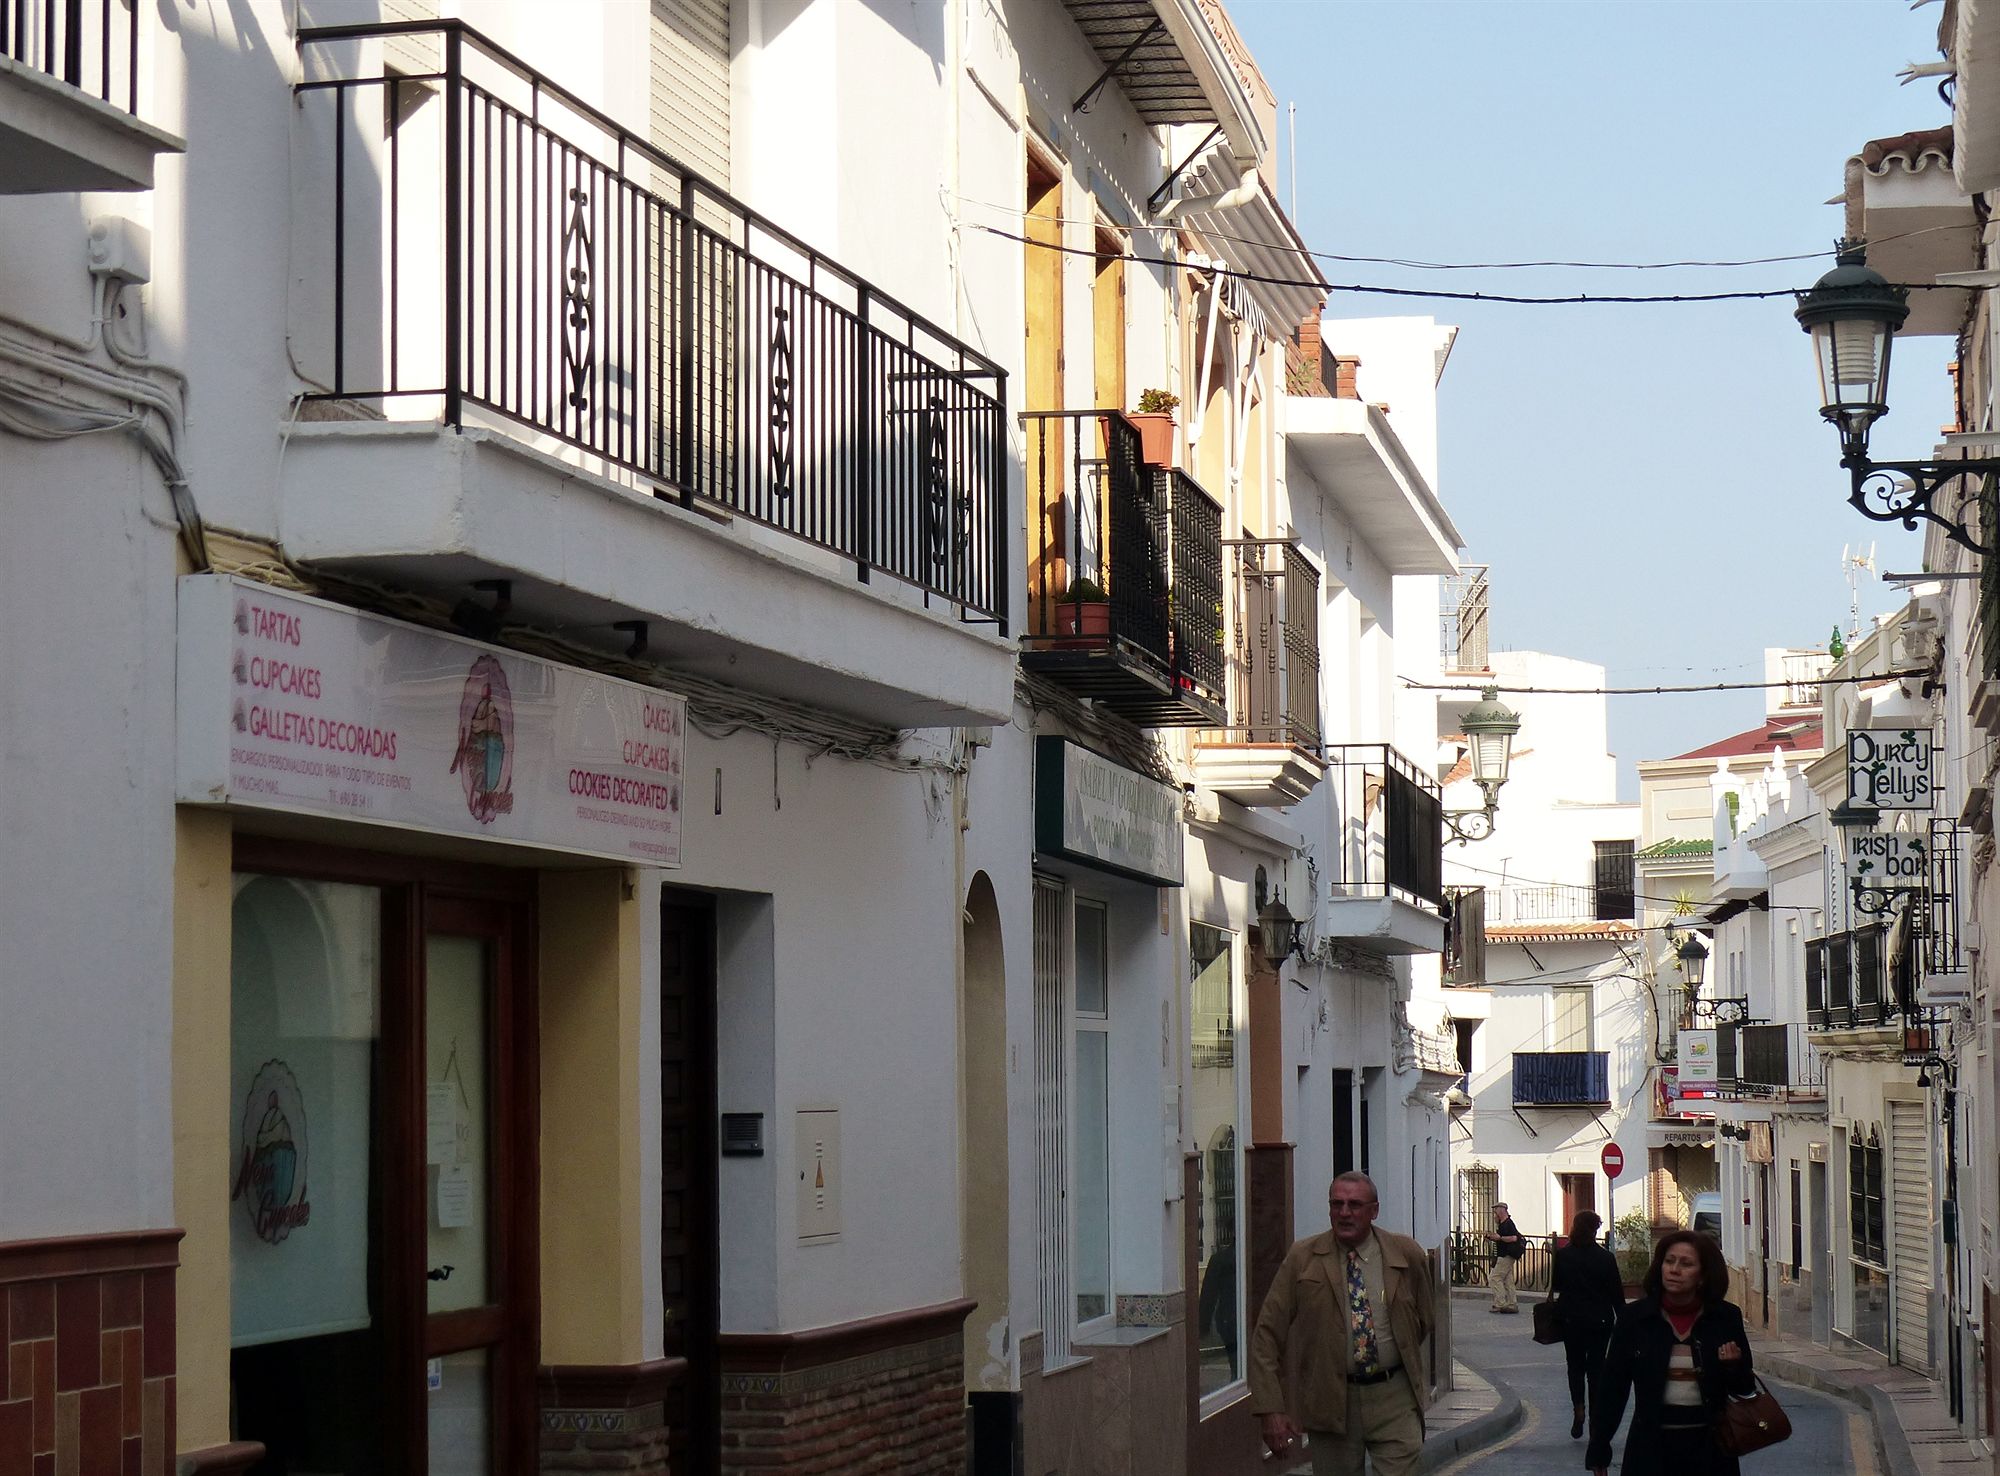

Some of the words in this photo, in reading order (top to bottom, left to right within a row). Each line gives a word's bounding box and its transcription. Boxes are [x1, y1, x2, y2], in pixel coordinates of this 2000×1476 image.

[251, 606, 301, 646] TARTAS
[250, 656, 322, 699] CUPCAKES
[250, 705, 315, 746] GALLETAS
[318, 719, 397, 760] DECORADAS
[643, 704, 671, 733] CAKES
[623, 739, 670, 772] CUPCAKES
[569, 769, 611, 801] COOKIES
[612, 779, 668, 810] DECORATED
[1664, 1133, 1701, 1142] REPARTOS
